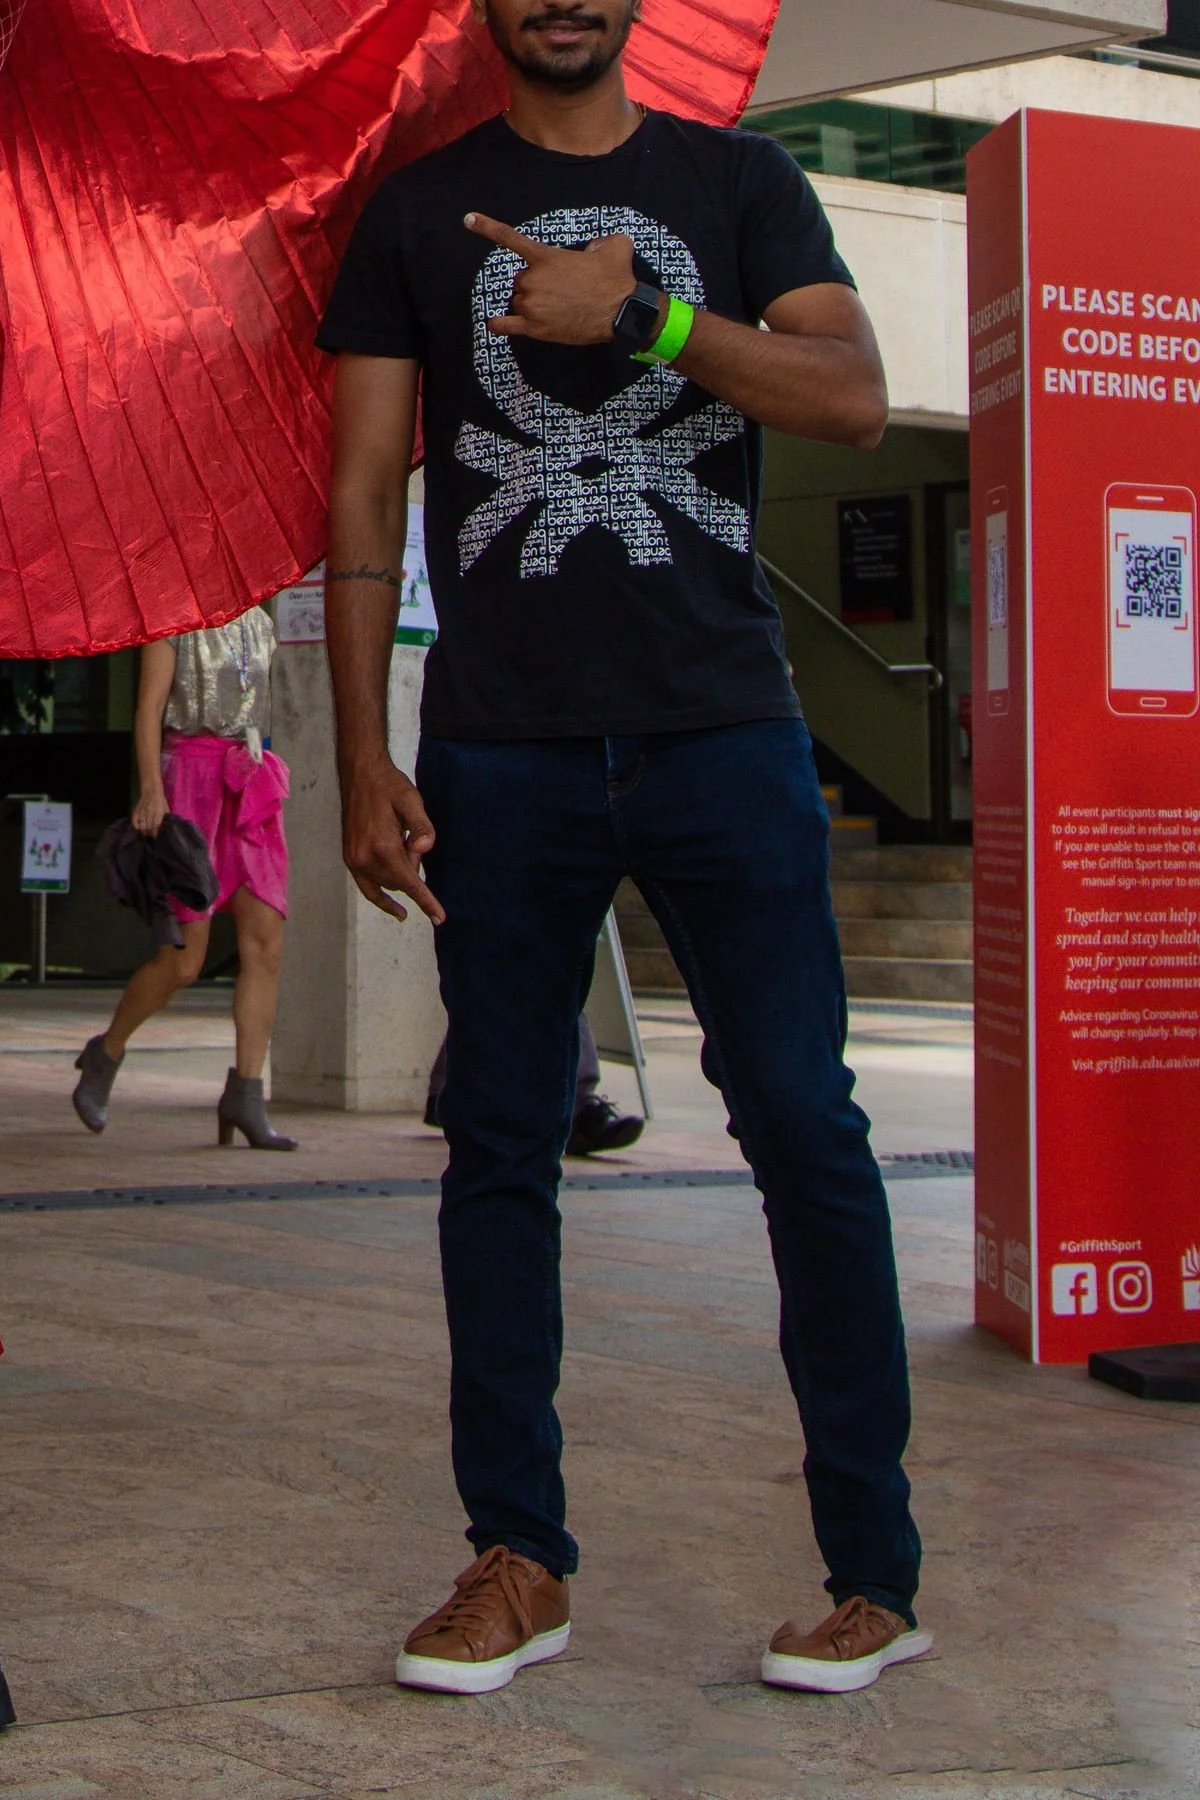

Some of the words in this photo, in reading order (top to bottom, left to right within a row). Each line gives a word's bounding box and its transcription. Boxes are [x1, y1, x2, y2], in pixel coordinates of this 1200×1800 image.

[993, 292, 1010, 325] SCAN
[1043, 284, 1135, 317] PLEASE
[1063, 327, 1132, 357] CODE
[975, 344, 991, 374] CODE
[1001, 370, 1021, 400] EVENT
[1044, 367, 1166, 401] ENTERING
[611, 502, 656, 520] benetto
[1059, 805, 1070, 817] All
[1073, 808, 1099, 817] event
[1102, 808, 1155, 819] participants
[1159, 808, 1183, 818] must
[1052, 824, 1062, 834] to
[1065, 823, 1076, 834] do
[1079, 825, 1089, 834] so
[1092, 824, 1108, 834] will
[1110, 824, 1136, 835] result
[1138, 825, 1146, 835] in
[1149, 824, 1179, 835] refusal
[1182, 826, 1191, 835] to
[1056, 840, 1062, 851] If
[1064, 842, 1082, 854] you
[1084, 842, 1099, 851] are
[1102, 841, 1132, 852] unable
[1135, 843, 1144, 852] to
[1147, 844, 1162, 852] use
[1165, 841, 1179, 852] the
[1182, 841, 1196, 854] QR
[1062, 860, 1078, 869] see
[1081, 858, 1096, 869] the
[1099, 858, 1133, 869] Griffith
[1136, 858, 1161, 871] Sport
[1164, 860, 1186, 869] team
[1082, 876, 1115, 886] manual
[1152, 877, 1174, 888] prior
[1176, 878, 1186, 886] to
[1065, 908, 1122, 927] Together
[1125, 912, 1142, 922] we
[1144, 912, 1167, 922] can
[1169, 908, 1197, 926] help
[1057, 930, 1101, 949] spread
[1104, 930, 1129, 944] and
[1132, 933, 1158, 948] stay
[1068, 956, 1092, 971] you
[1093, 952, 1114, 971] for
[1116, 956, 1147, 971] your
[1065, 975, 1118, 993] keeping
[1120, 978, 1143, 989] our
[1060, 1010, 1092, 1022] Advice
[1095, 1009, 1140, 1023] regarding
[1144, 1008, 1199, 1020] Coronavirus
[1072, 1027, 1088, 1039] will
[1091, 1027, 1125, 1041] change
[1072, 1059, 1093, 1070] Visit
[1060, 1239, 1142, 1253] #GriffithSport
